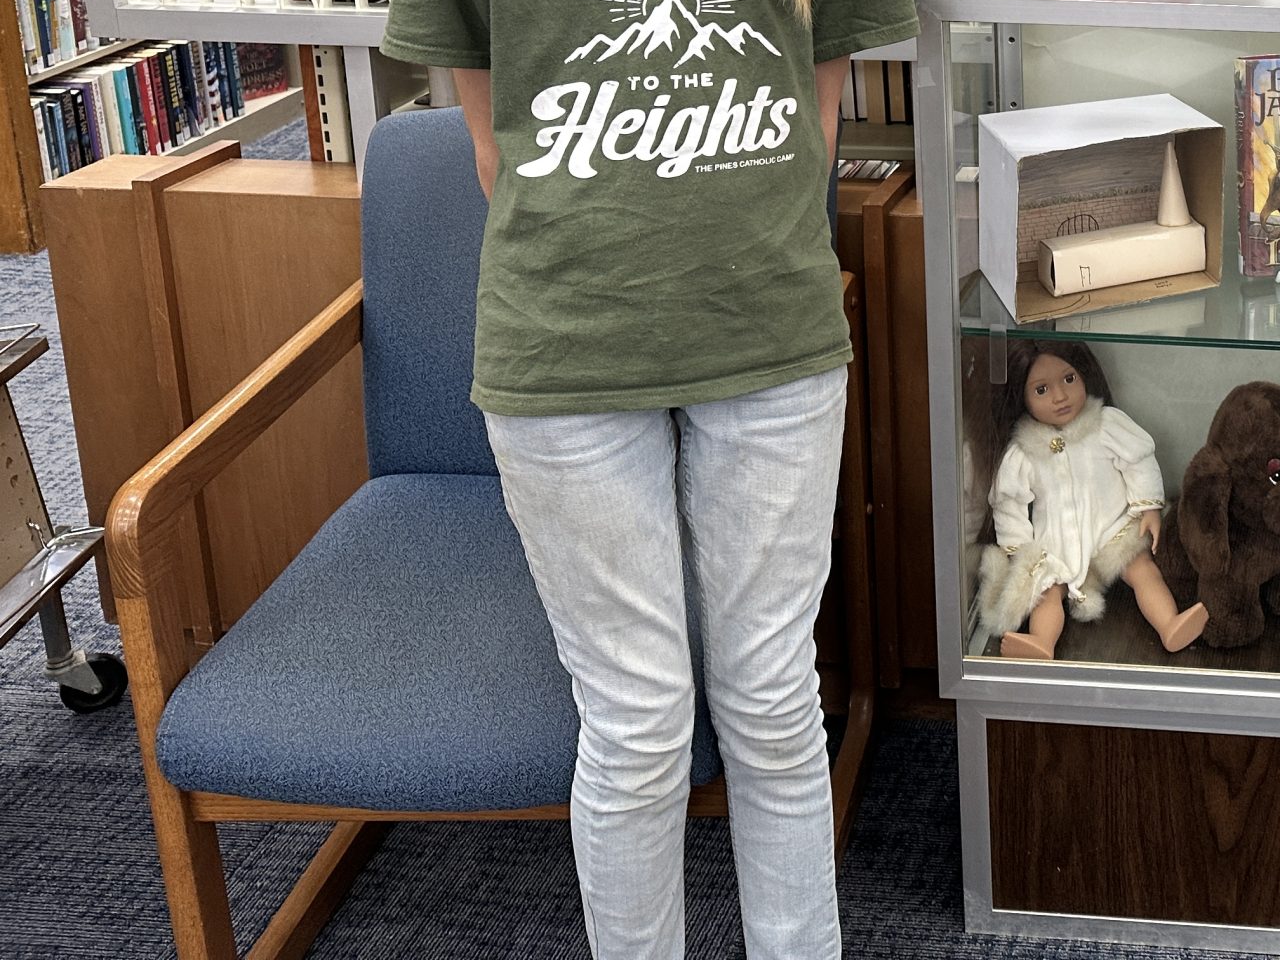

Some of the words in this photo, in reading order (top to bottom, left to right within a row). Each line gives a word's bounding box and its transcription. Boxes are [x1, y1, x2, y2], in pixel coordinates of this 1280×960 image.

[627, 75, 660, 91] TO
[670, 72, 714, 90] THE
[515, 77, 798, 179] Heights
[695, 165, 713, 173] THE
[714, 161, 738, 171] PINES
[739, 156, 776, 168] CATHOLIC
